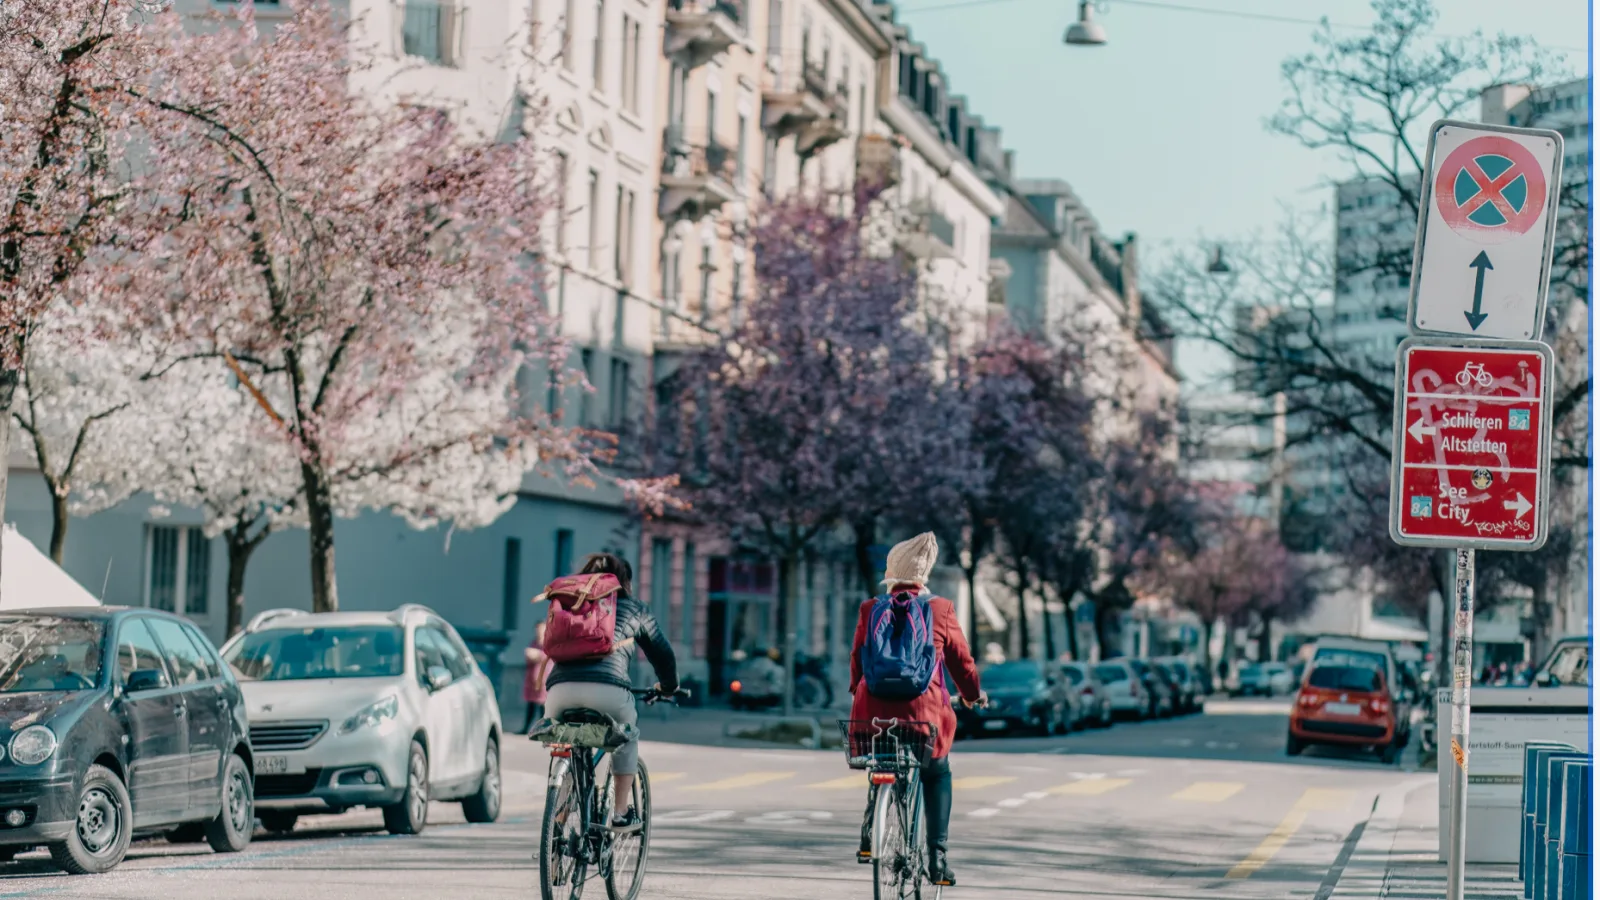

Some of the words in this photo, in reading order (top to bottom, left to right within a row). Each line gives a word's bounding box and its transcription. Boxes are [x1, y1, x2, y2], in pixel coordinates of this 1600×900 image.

[1442, 411, 1503, 430] Schlieren
[1441, 435, 1508, 454] Altstetten
[1438, 482, 1468, 499] See
[1437, 502, 1471, 524] City
[1468, 741, 1524, 749] ertstoff-Sam
